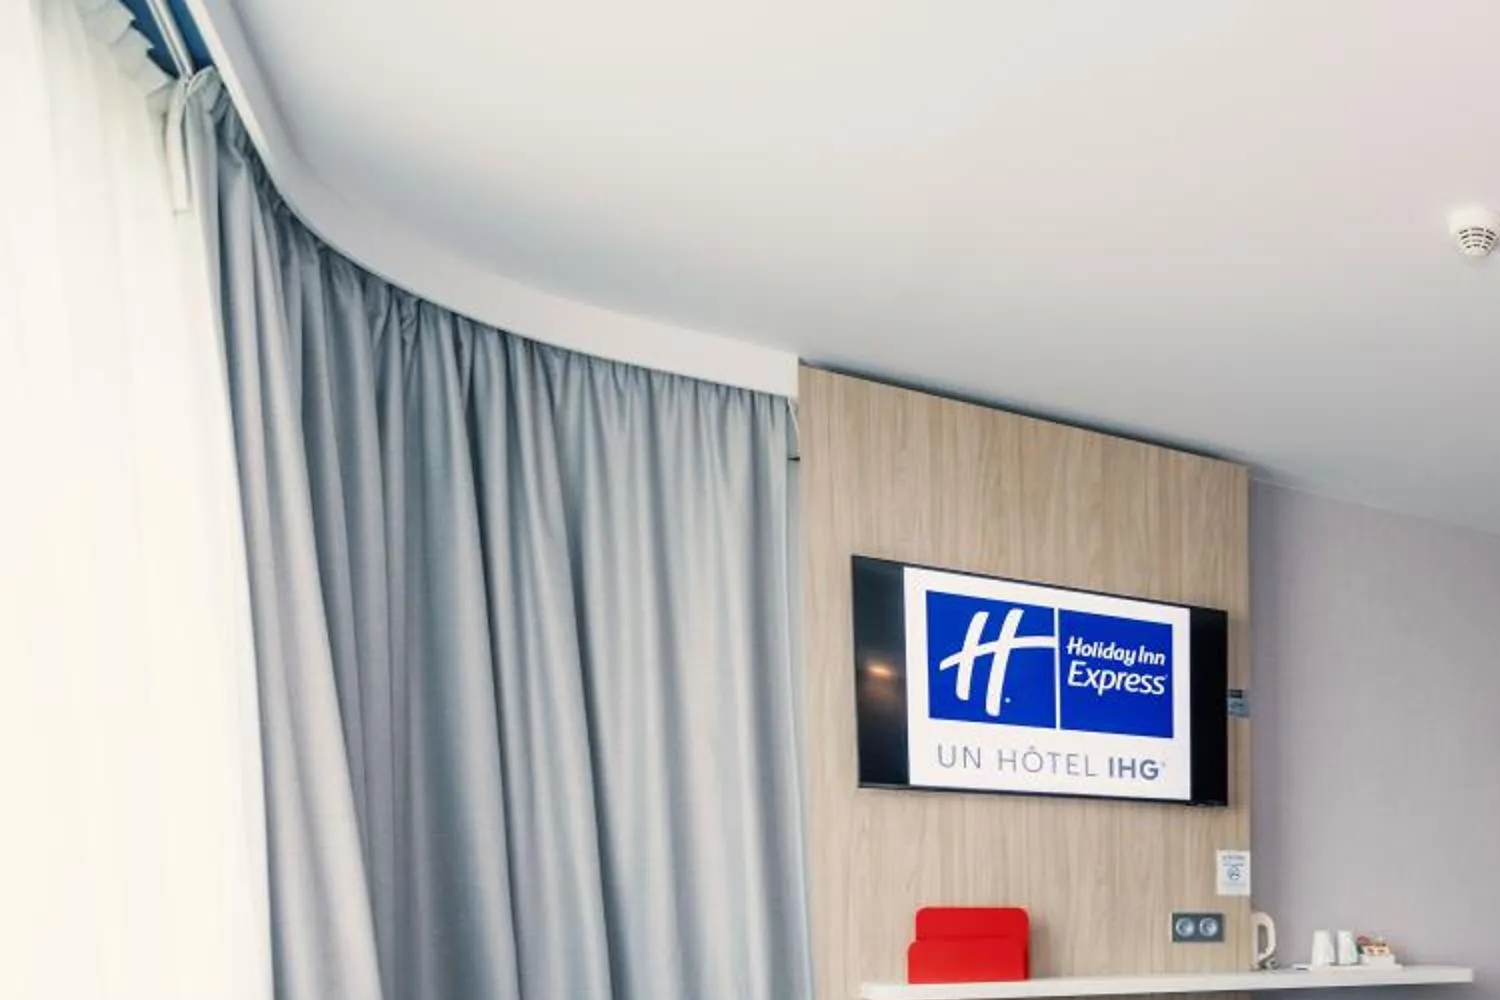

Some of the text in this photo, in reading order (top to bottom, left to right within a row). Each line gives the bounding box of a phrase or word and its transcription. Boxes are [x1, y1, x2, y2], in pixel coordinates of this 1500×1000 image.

[1066, 636, 1165, 667] Holiday Inn
[1067, 660, 1165, 696] Express
[937, 744, 982, 769] UN
[997, 746, 1099, 777] HÔTEL
